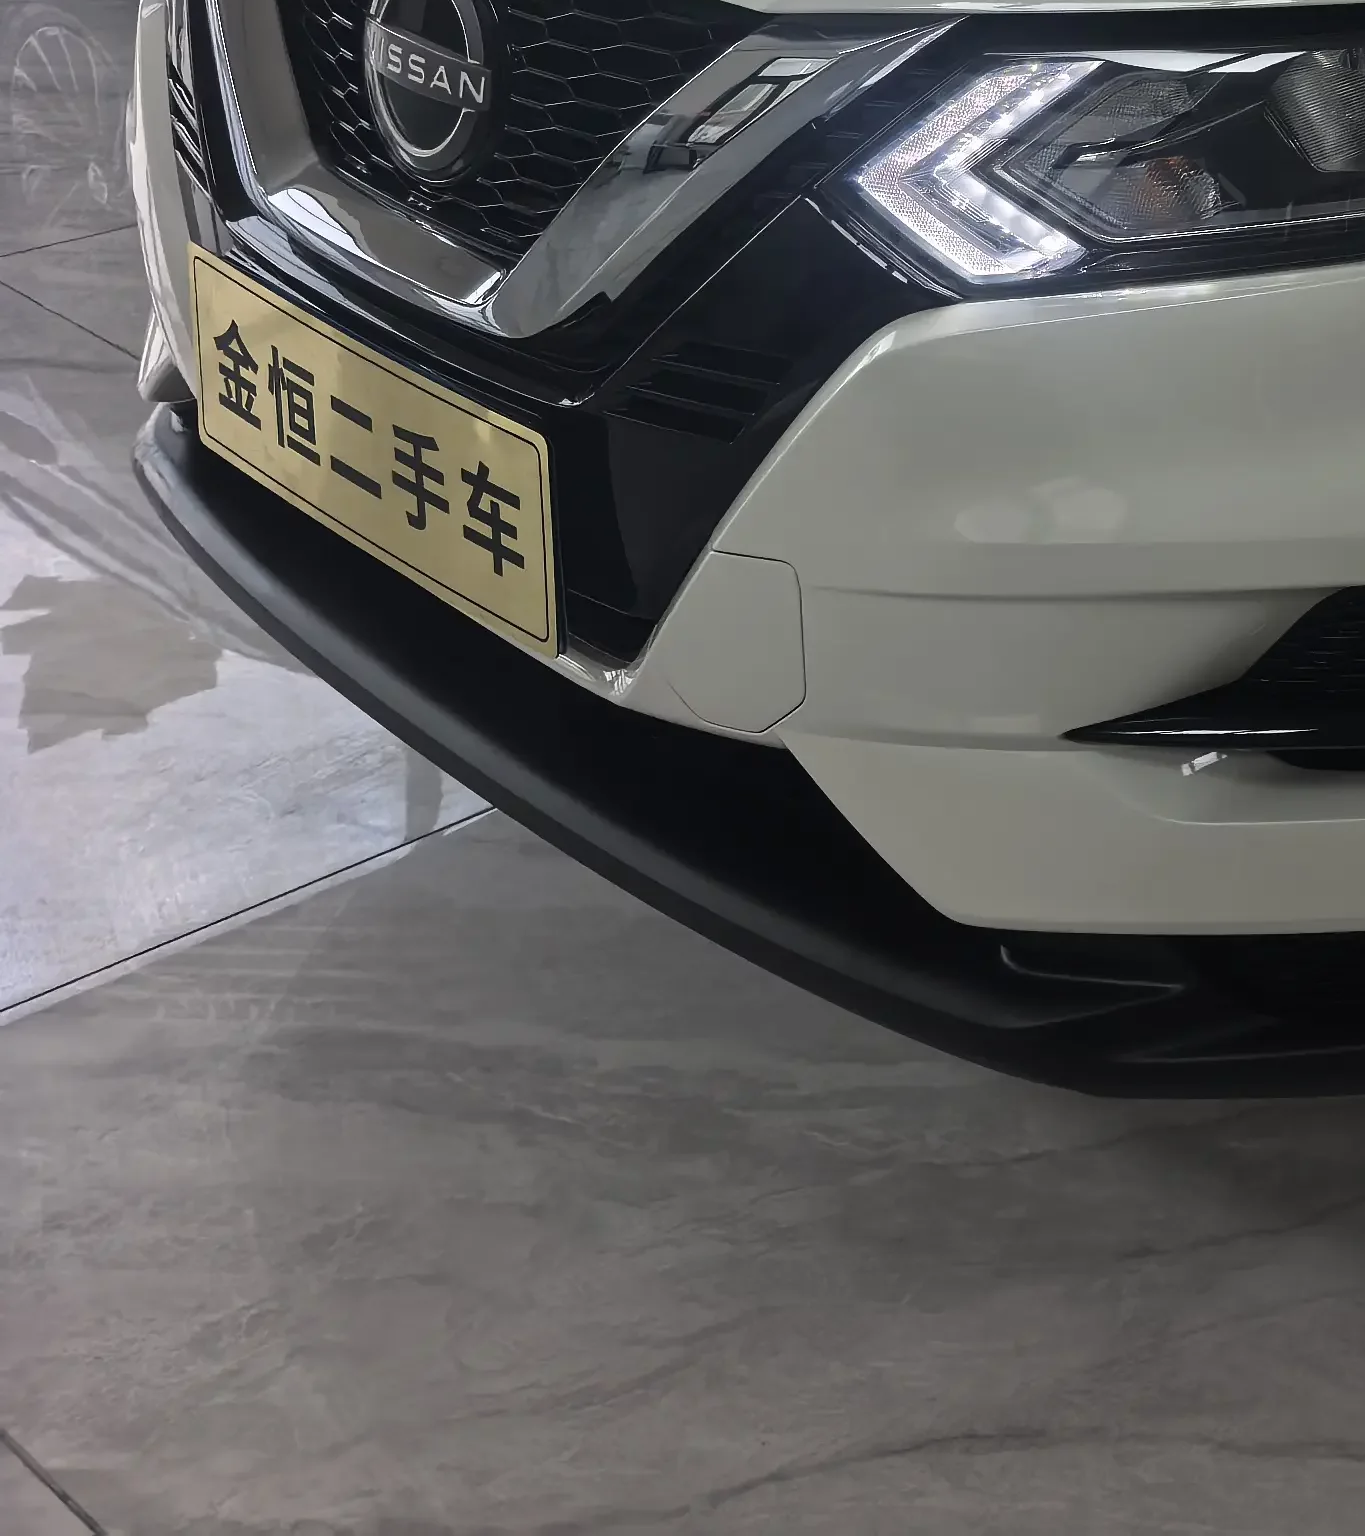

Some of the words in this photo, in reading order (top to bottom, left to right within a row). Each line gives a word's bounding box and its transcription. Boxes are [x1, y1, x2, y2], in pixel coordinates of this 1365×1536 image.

[213, 319, 525, 577] 金恒二手车
